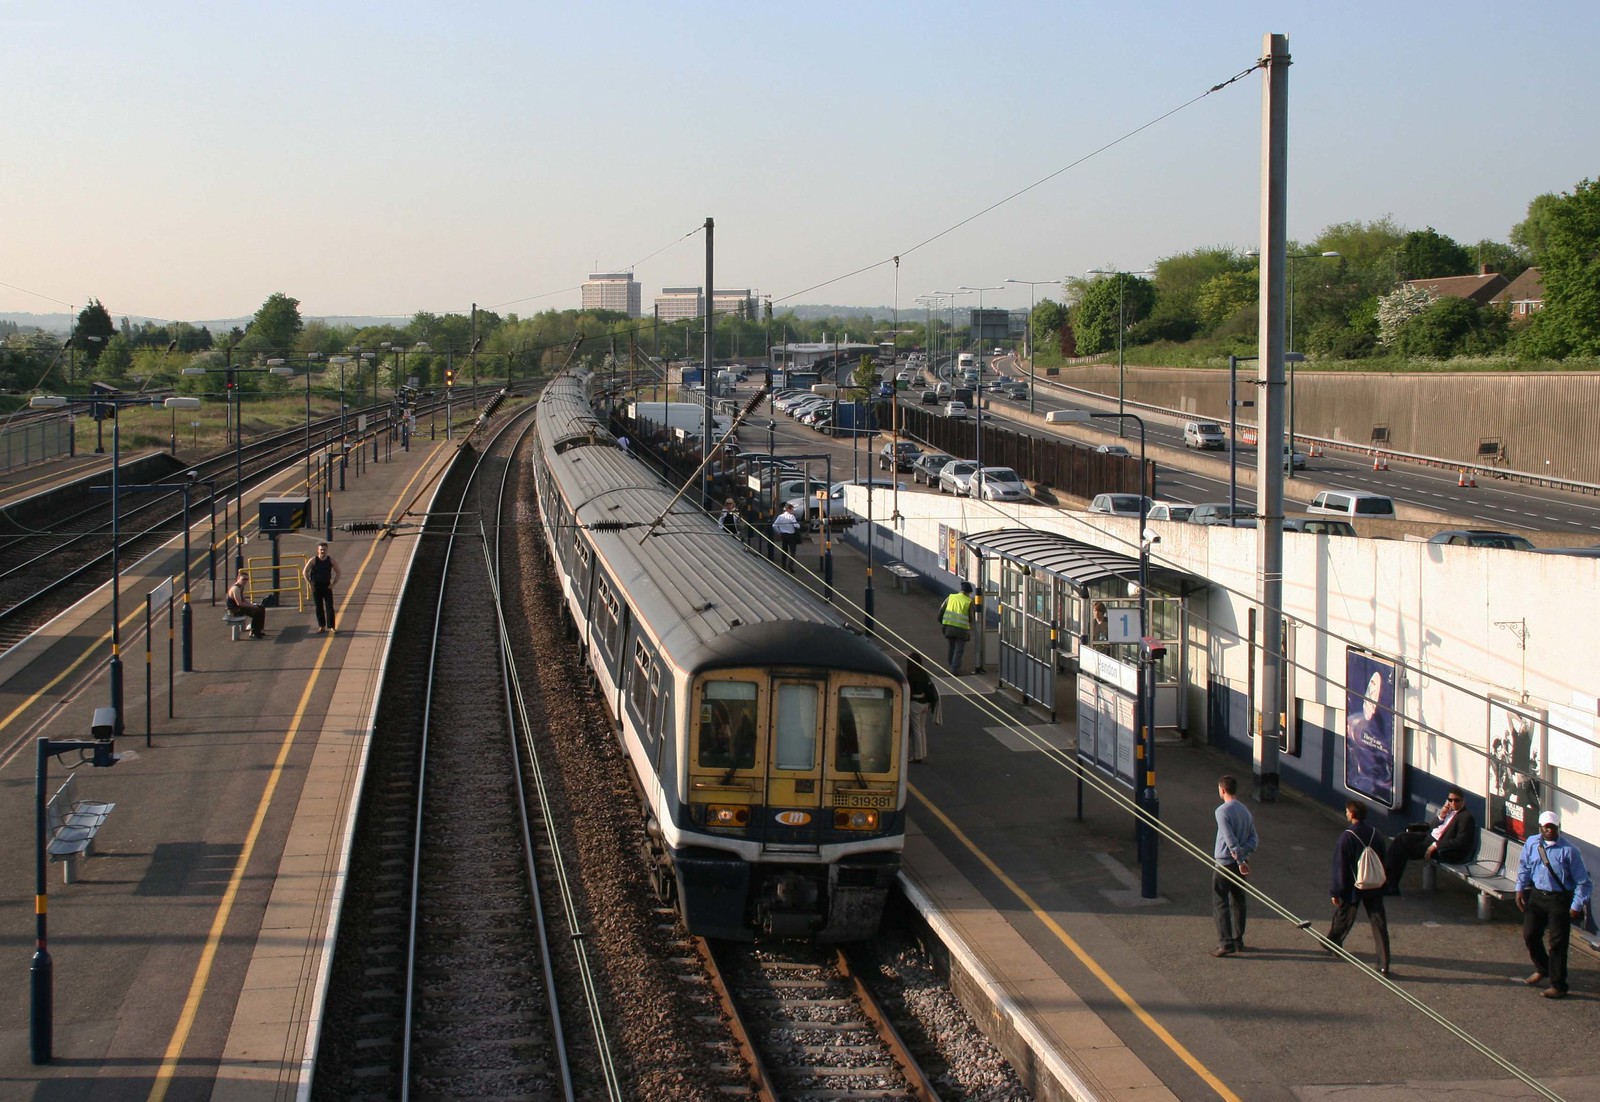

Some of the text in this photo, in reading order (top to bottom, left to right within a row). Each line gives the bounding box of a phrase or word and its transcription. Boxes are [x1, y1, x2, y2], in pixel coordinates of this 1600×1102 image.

[270, 515, 277, 524] 4
[1120, 614, 1128, 637] 1
[851, 796, 891, 807] 319381
